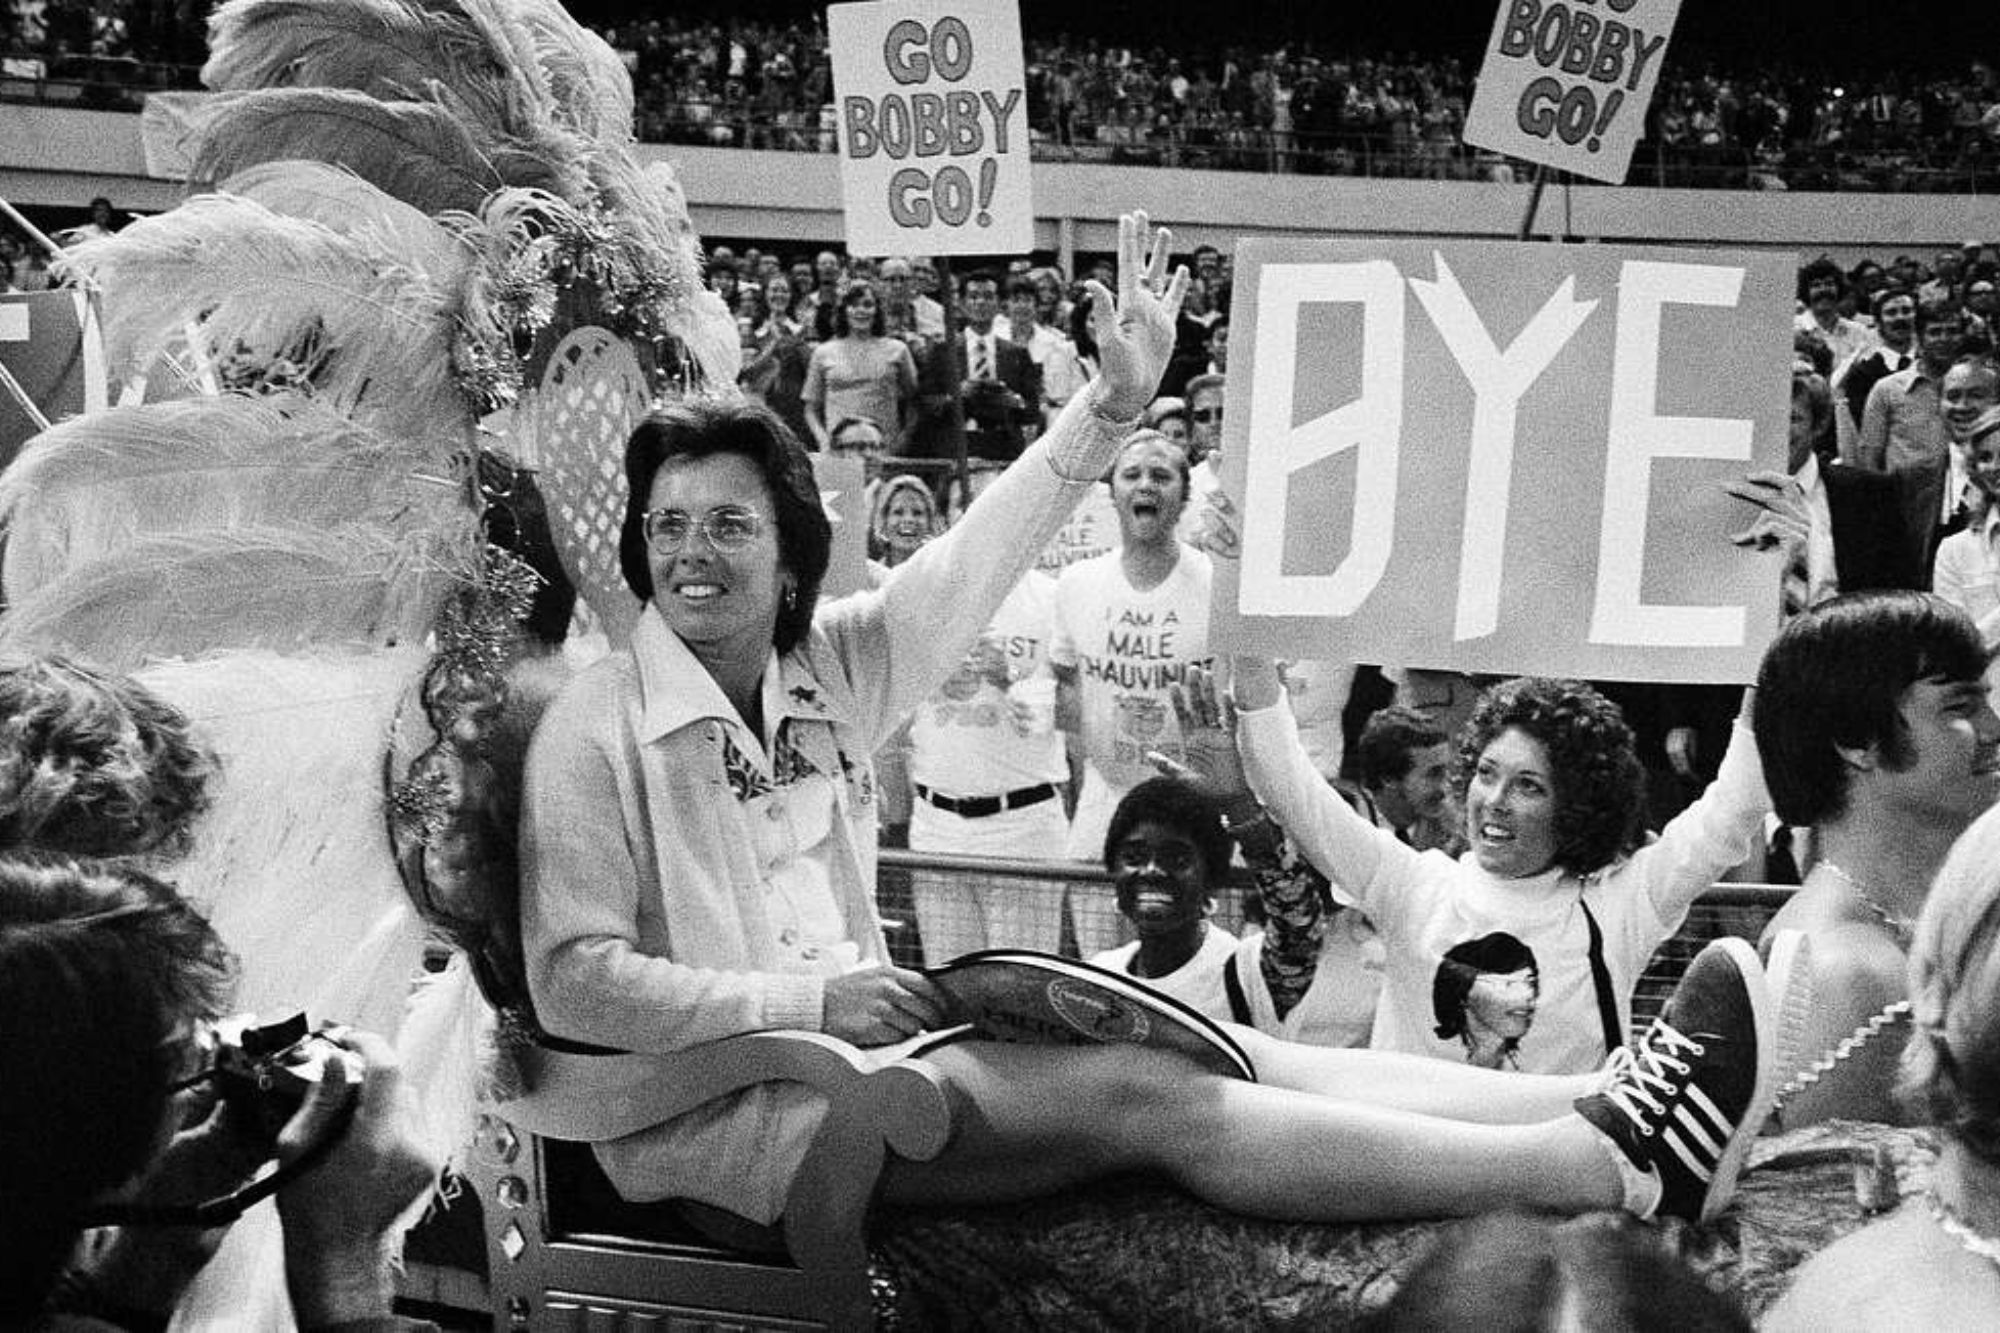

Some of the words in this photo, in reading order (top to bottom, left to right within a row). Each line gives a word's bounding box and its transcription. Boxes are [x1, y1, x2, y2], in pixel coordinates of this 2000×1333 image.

[883, 16, 973, 85] GO
[1500, 0, 1665, 91] BOBBY
[844, 89, 1022, 160] BOBBY
[1517, 76, 1625, 153] GO!
[888, 157, 998, 228] GO!
[1239, 250, 1755, 646] BYE
[1106, 630, 1174, 660] MALE
[1119, 610, 1154, 626] AM
[1162, 611, 1179, 626] A
[1081, 655, 1215, 690] HAUVINIT
